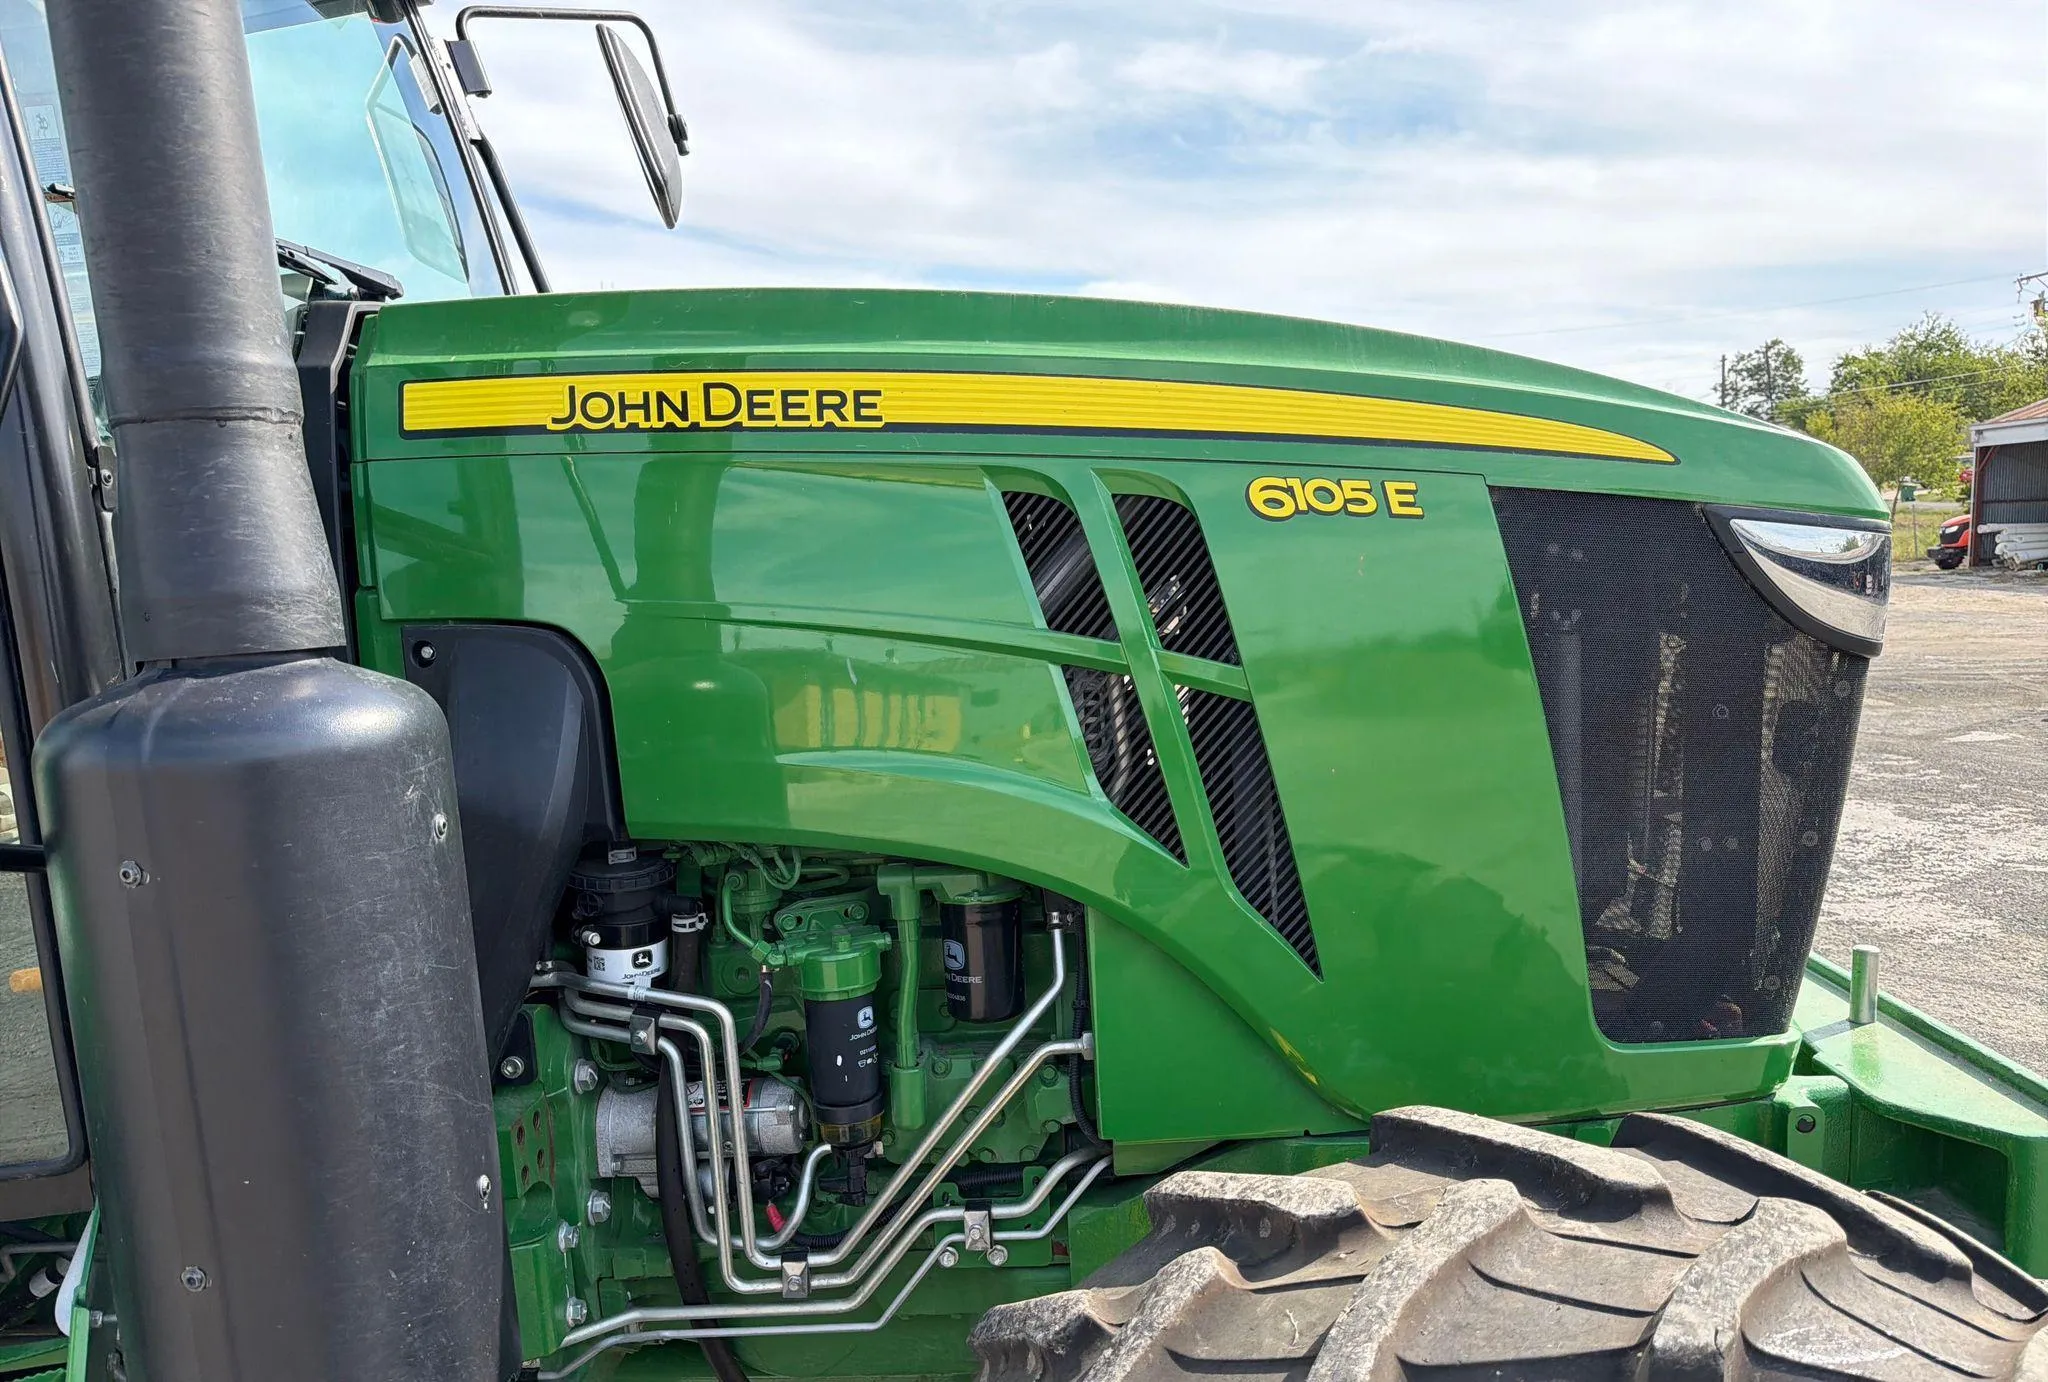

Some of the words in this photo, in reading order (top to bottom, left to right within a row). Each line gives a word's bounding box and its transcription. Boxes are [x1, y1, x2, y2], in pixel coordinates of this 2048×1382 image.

[550, 384, 690, 425] JOHN
[701, 381, 885, 423] DEERE
[1245, 476, 1379, 522] 6105
[1380, 479, 1425, 519] E
[951, 973, 984, 984] DEERE
[849, 1032, 867, 1041] JOHN
